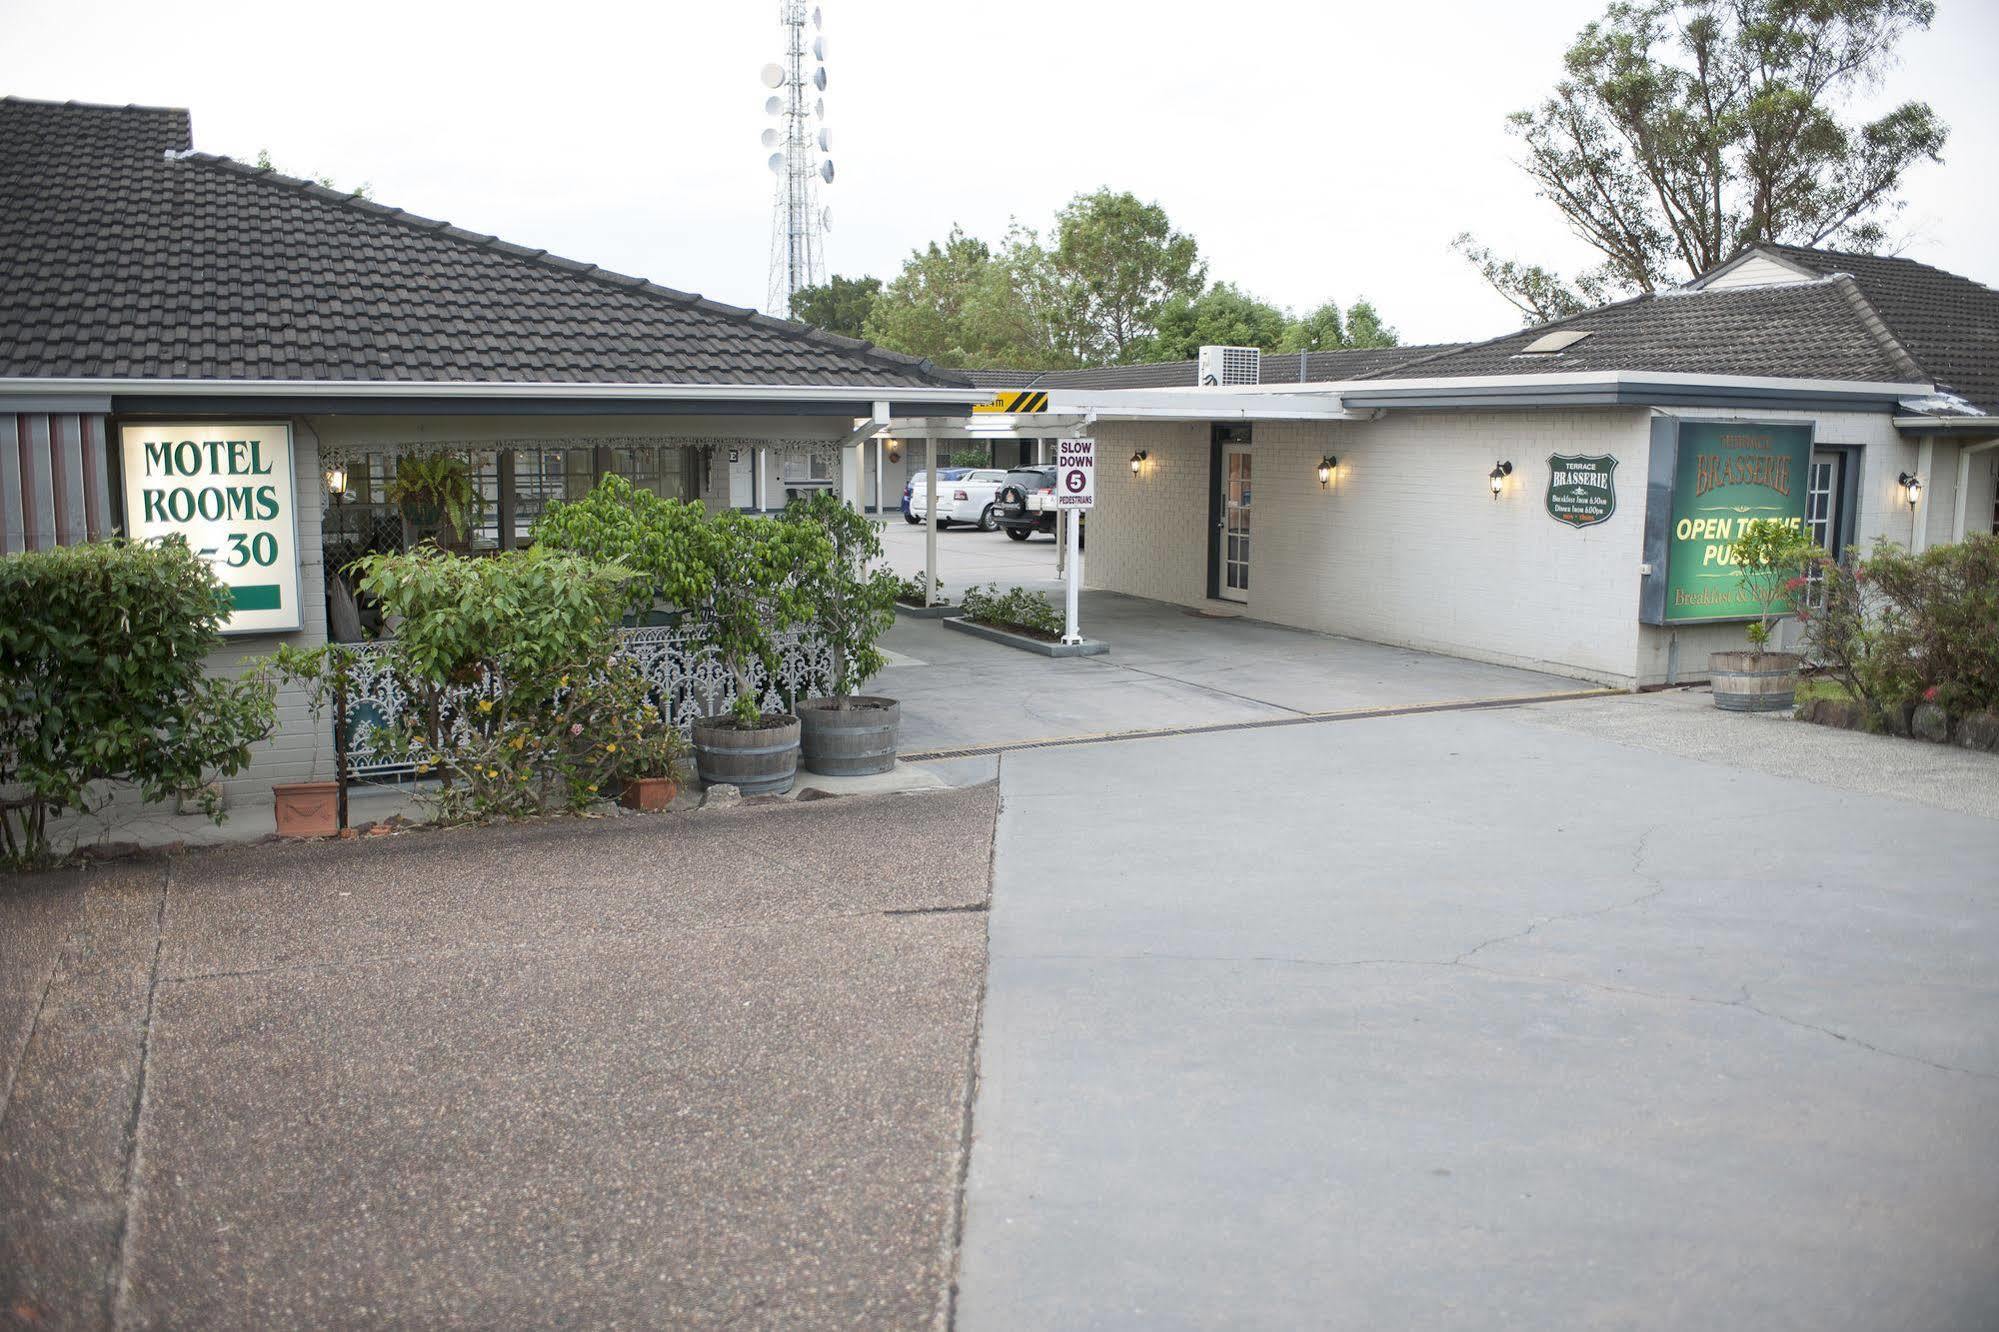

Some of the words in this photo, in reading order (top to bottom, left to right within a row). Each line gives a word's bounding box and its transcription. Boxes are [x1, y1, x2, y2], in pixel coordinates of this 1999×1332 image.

[1061, 442, 1092, 453] SLOW
[144, 440, 274, 477] MOTEL
[1060, 456, 1093, 467] DOWN
[1565, 463, 1596, 471] TERRACE
[1070, 473, 1083, 490] 5
[1553, 471, 1608, 490] BRASSERIE
[1696, 455, 1793, 498] BRASSERIE
[142, 485, 280, 523] ROOMS
[1059, 495, 1092, 504] PEDESTRIANS
[1676, 518, 1732, 540] OPEN
[226, 531, 279, 568] 30
[1674, 584, 1731, 606] Breakfast
